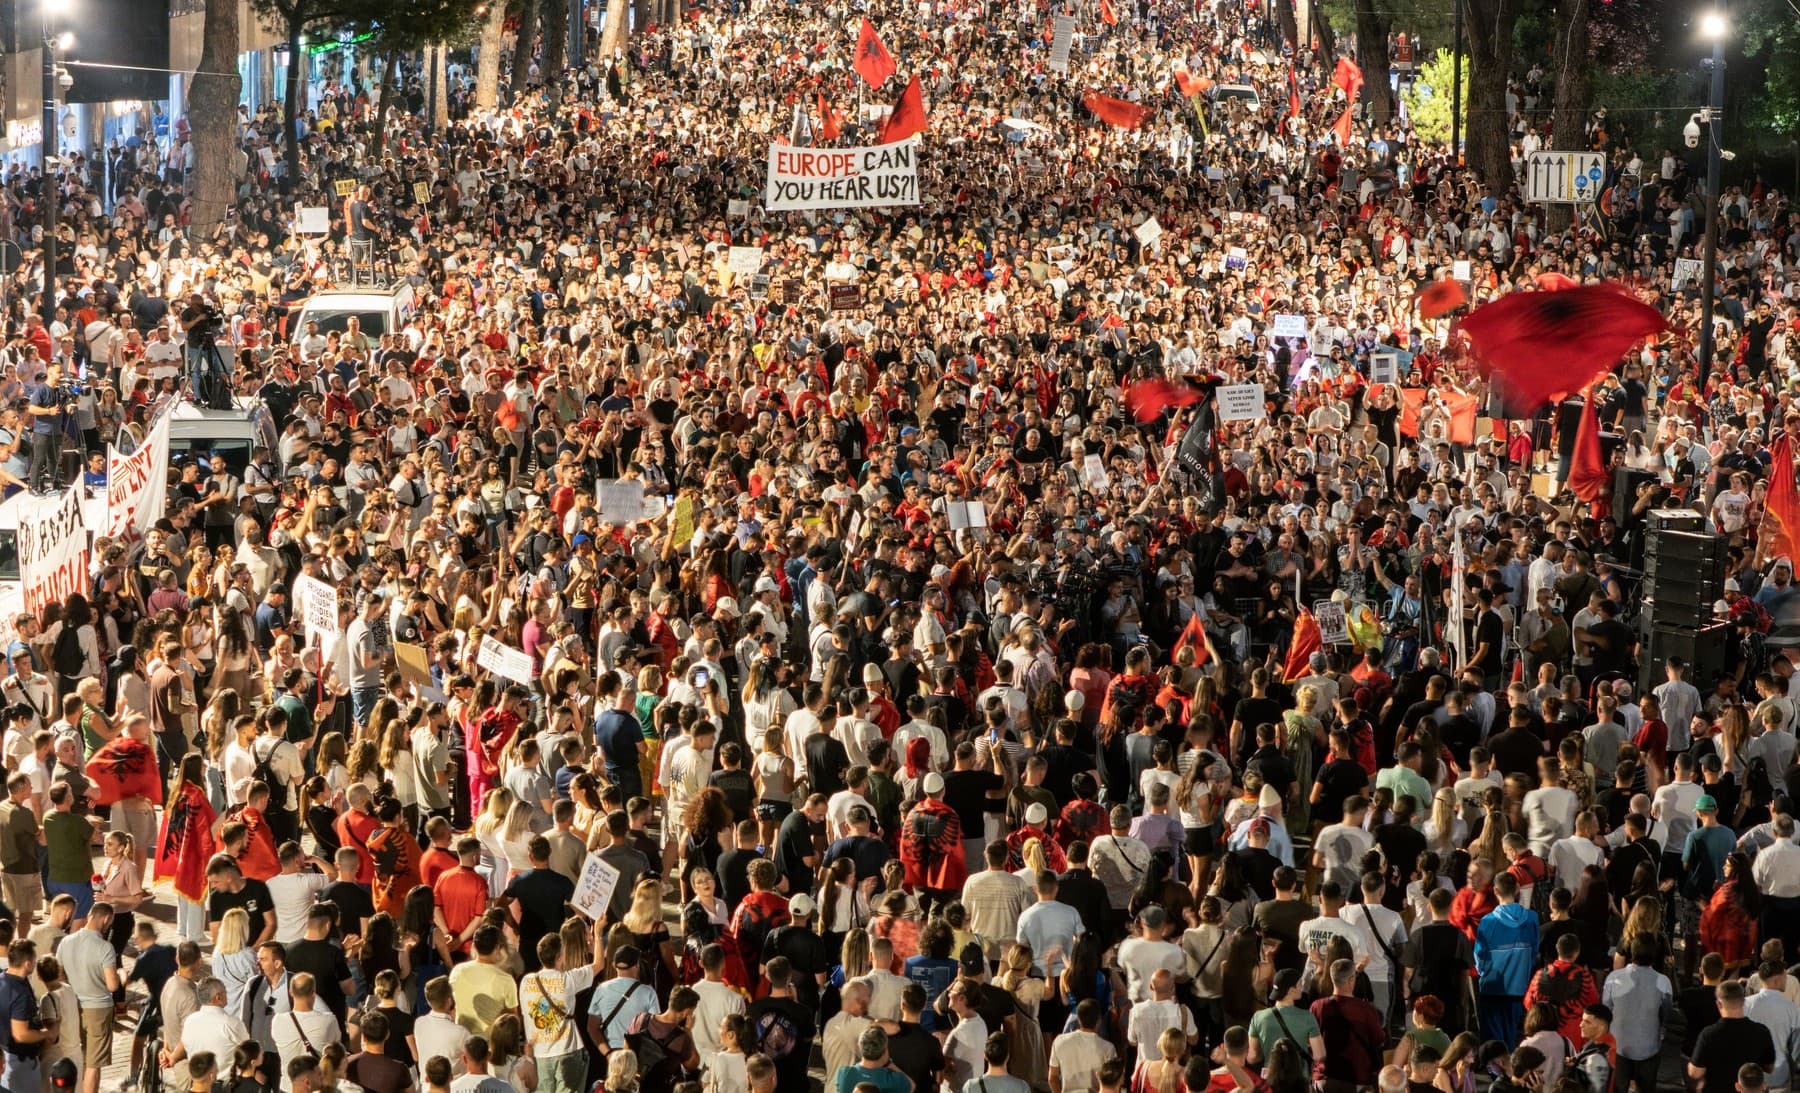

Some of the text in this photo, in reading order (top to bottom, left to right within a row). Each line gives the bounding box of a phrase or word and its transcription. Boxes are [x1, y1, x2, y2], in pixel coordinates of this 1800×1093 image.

[777, 145, 909, 177] EUROPE, CAN
[774, 175, 915, 202] YOU HEAR US?!
[1309, 930, 1333, 939] WHAT
